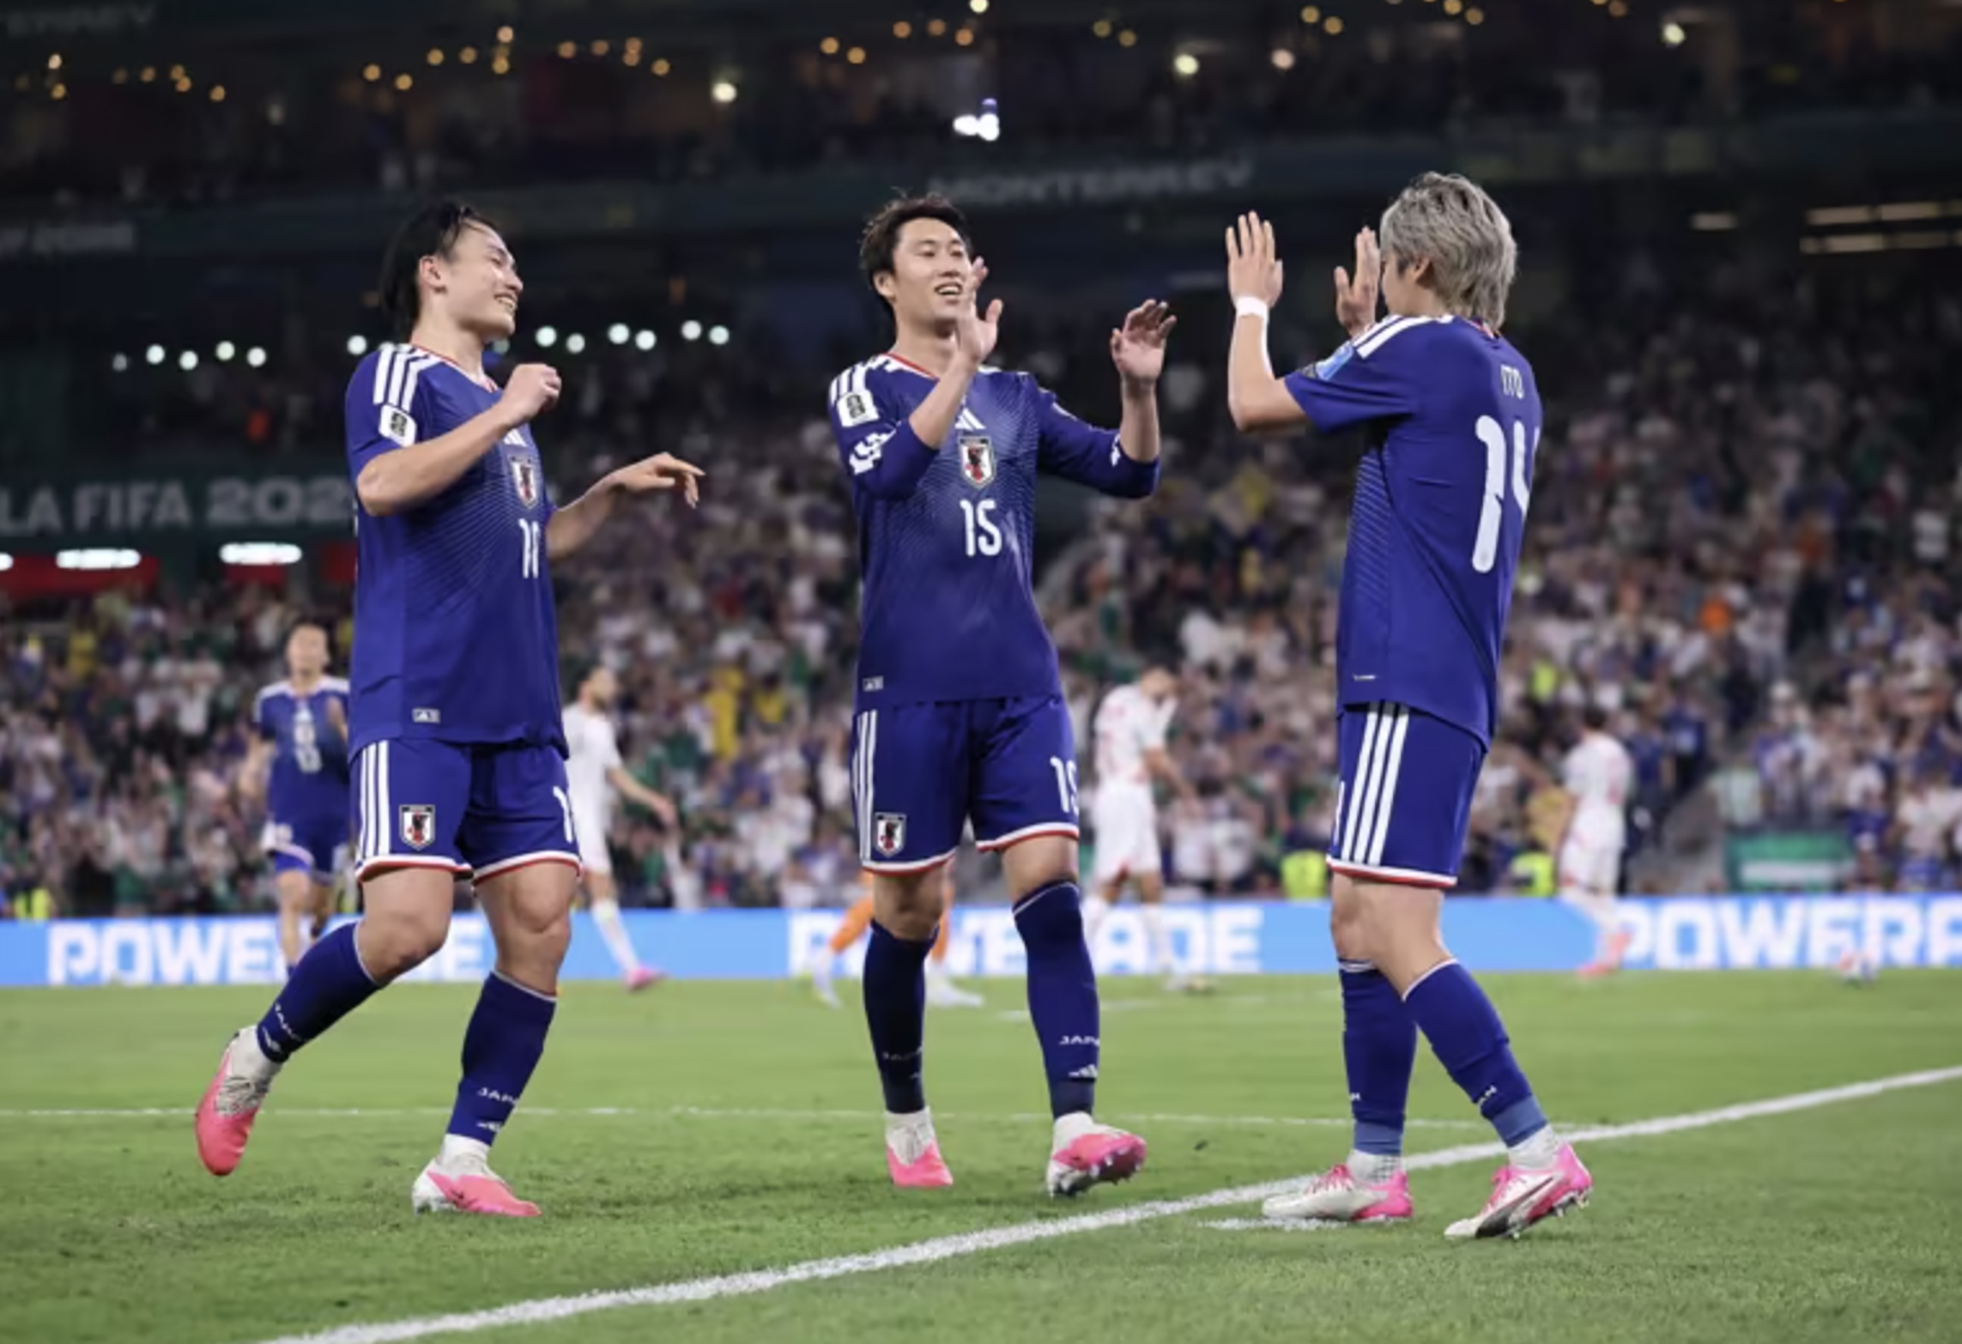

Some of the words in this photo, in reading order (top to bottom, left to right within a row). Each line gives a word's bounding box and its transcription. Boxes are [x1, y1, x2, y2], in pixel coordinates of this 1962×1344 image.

[0, 484, 63, 538] LA
[73, 478, 193, 532] FIFA
[206, 473, 351, 526] 202
[960, 498, 1003, 557] 15
[47, 921, 483, 985] POWEE
[788, 907, 1264, 976] PEADE
